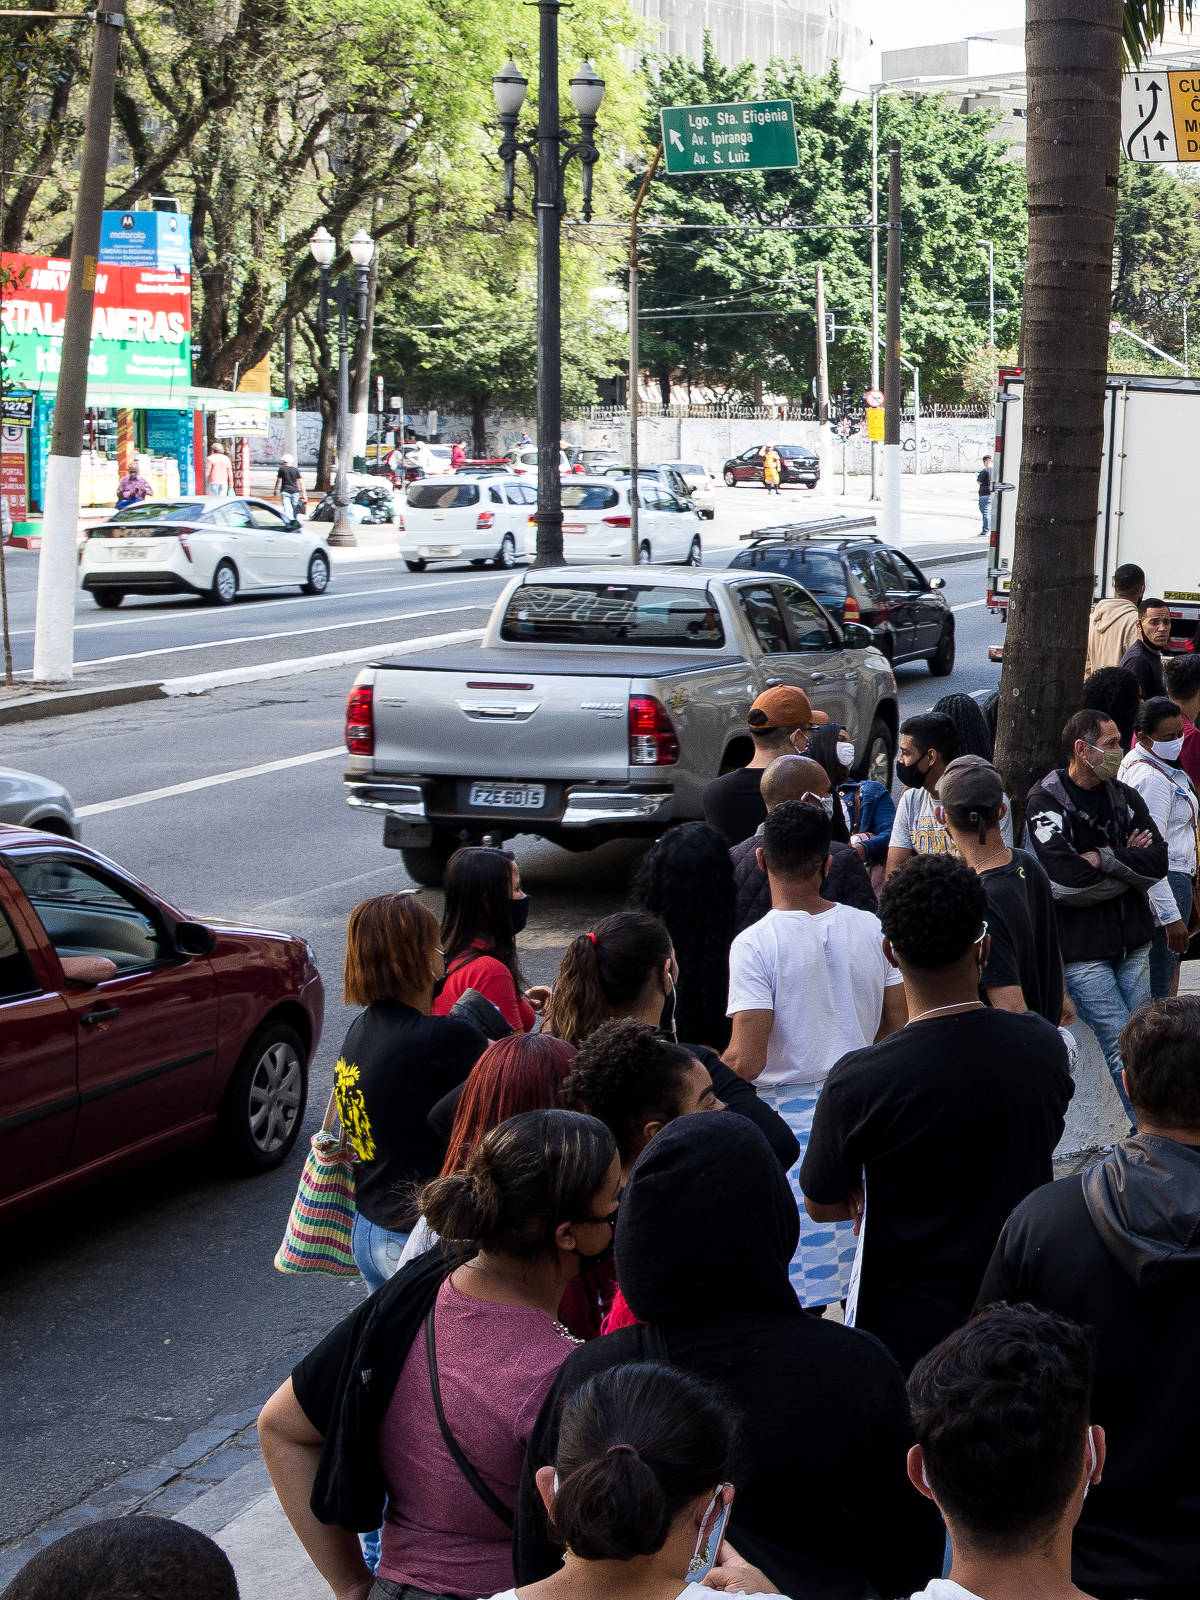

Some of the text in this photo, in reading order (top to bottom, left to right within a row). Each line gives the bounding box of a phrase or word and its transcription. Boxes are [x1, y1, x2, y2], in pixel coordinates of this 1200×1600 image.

[688, 108, 788, 129] Lgo. Sta. Efigênia
[691, 131, 753, 147] Av. Ipiranga
[693, 149, 750, 165] Av. S. Luiz
[110, 231, 146, 239] motorola
[91, 307, 185, 344] AMERAS
[580, 702, 624, 711] HILUX
